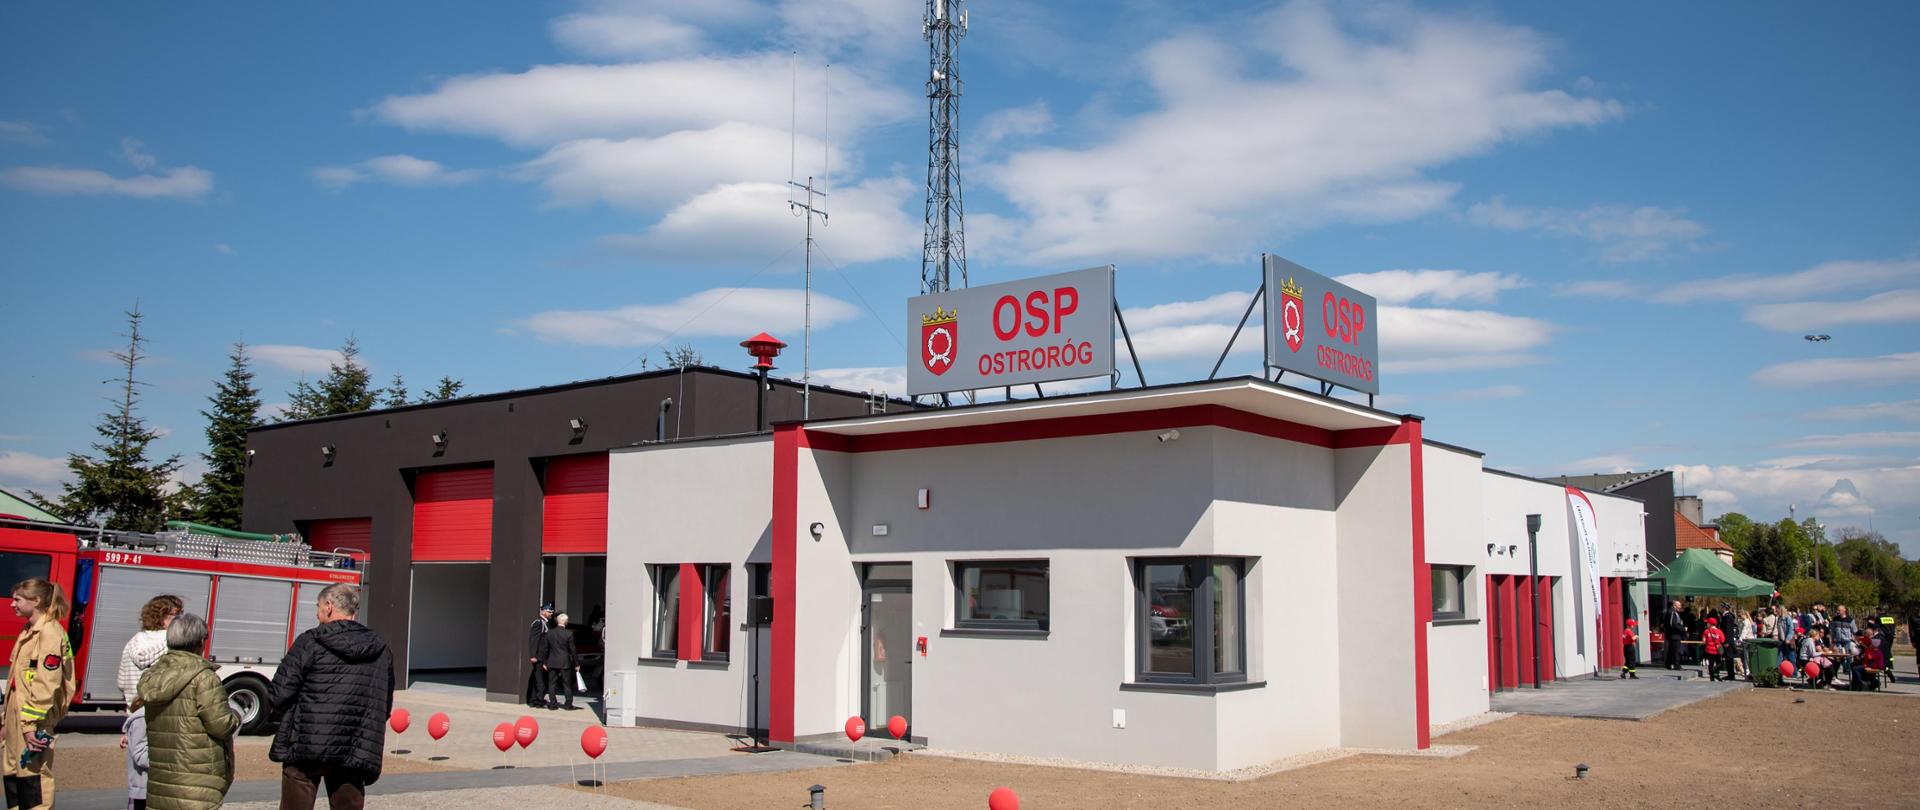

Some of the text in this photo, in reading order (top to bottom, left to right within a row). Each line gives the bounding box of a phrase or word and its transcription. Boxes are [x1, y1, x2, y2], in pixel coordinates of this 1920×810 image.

[993, 287, 1079, 341] OSP
[1323, 291, 1365, 346] OSP
[978, 338, 1093, 376] OSTRORÓG
[1317, 344, 1373, 382] OSTRORÓG
